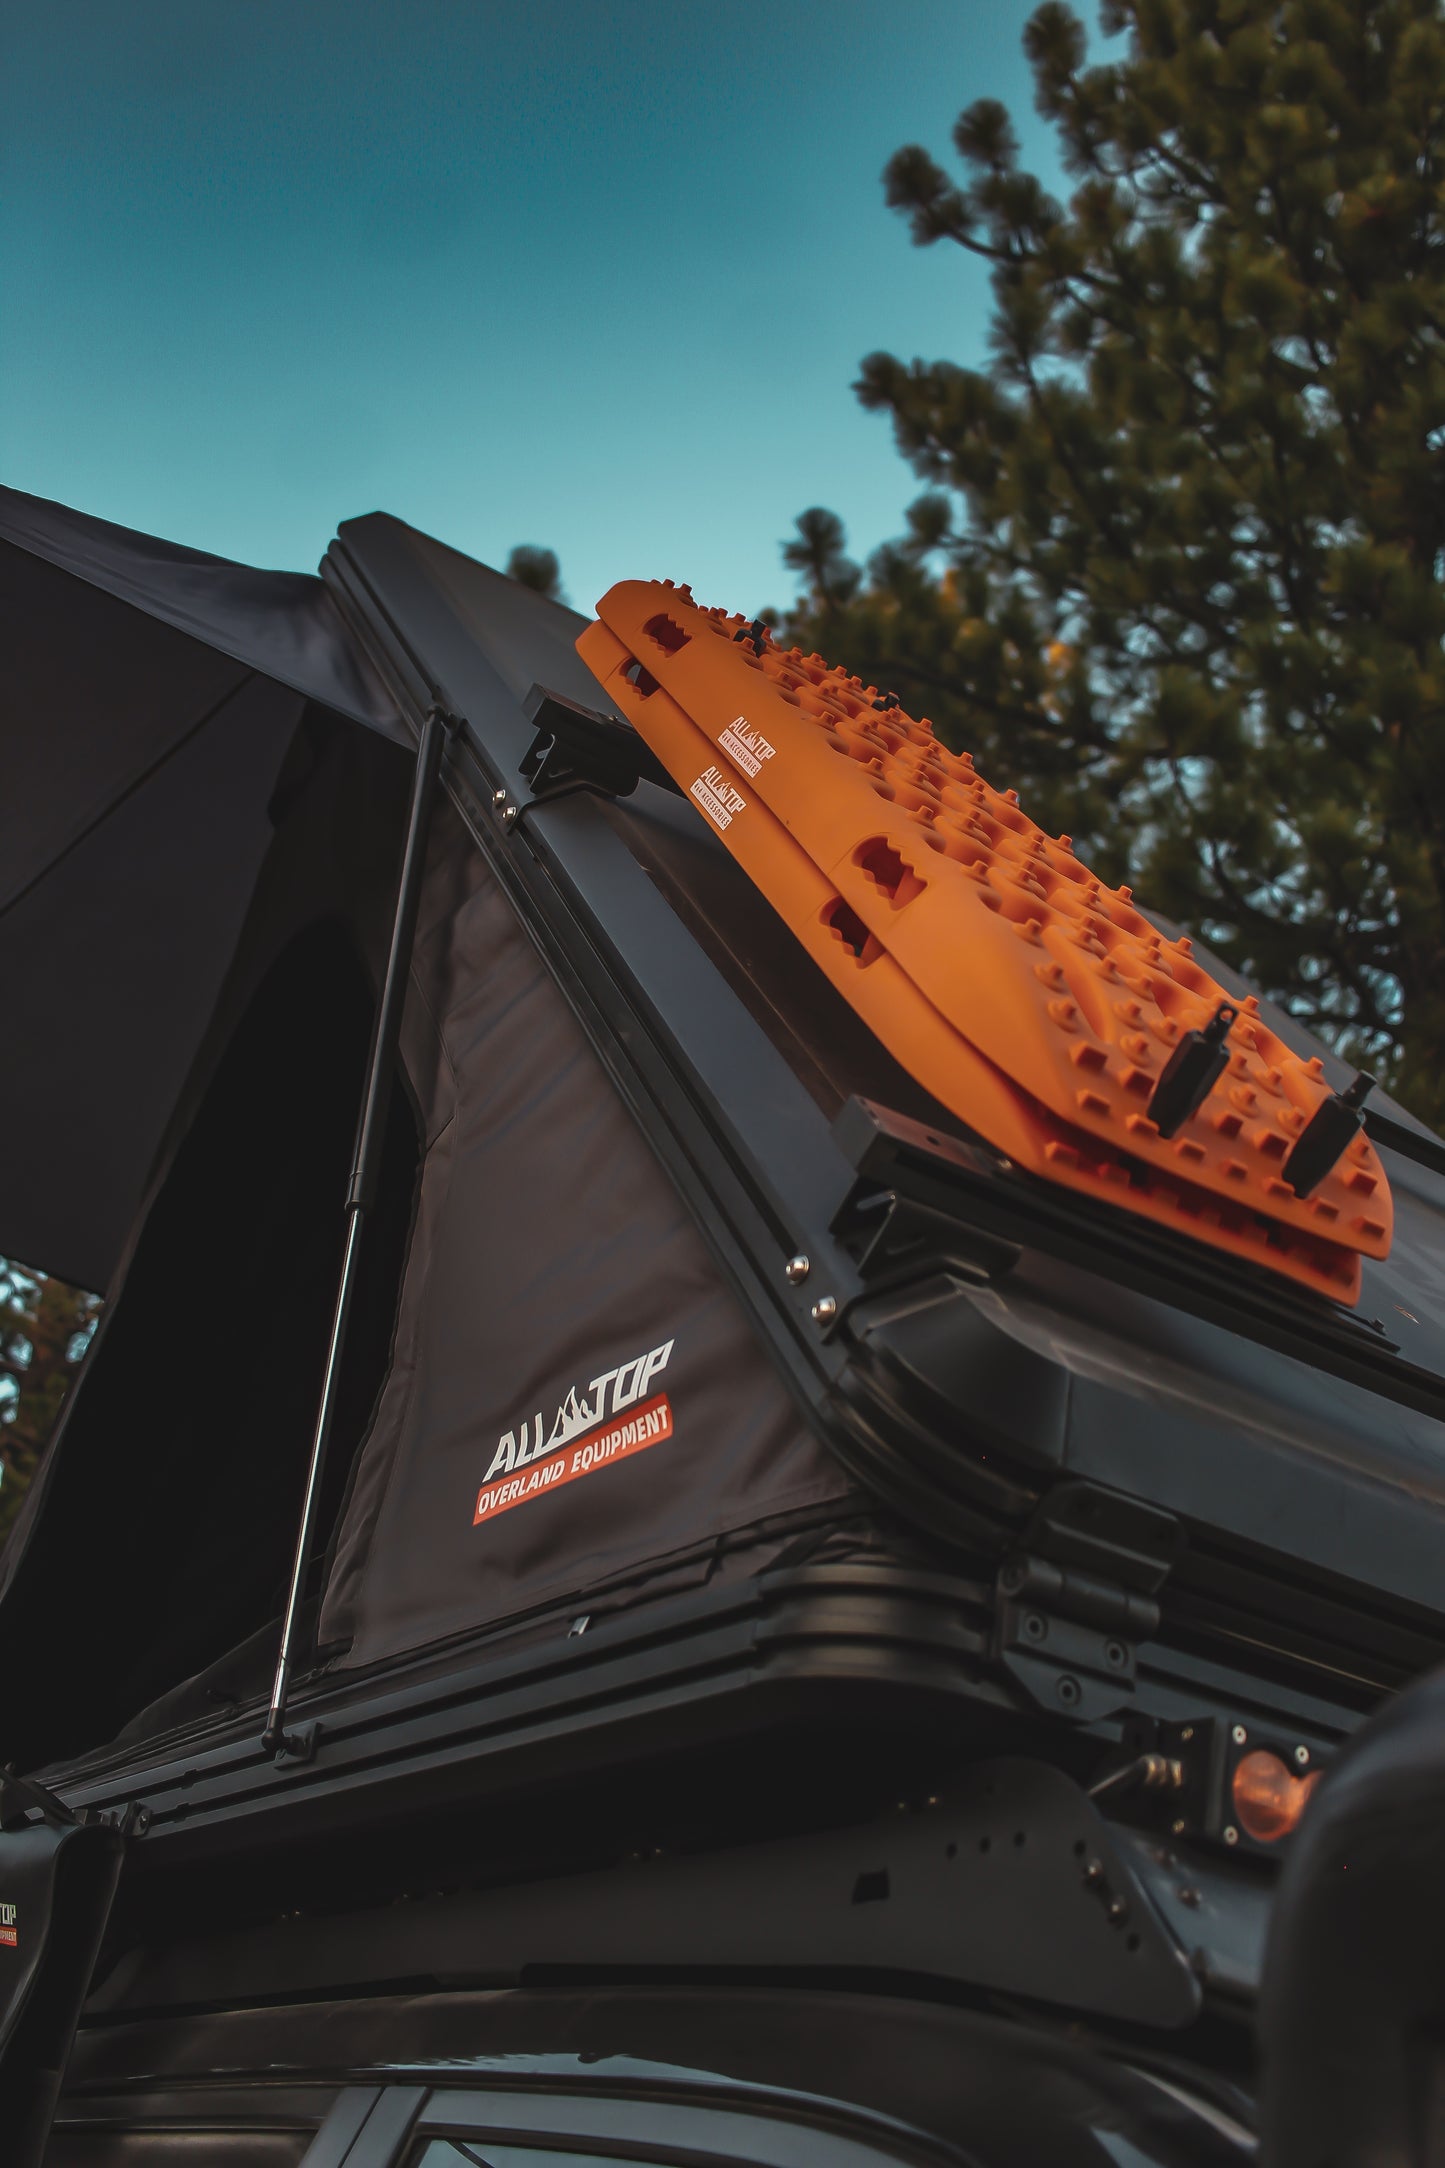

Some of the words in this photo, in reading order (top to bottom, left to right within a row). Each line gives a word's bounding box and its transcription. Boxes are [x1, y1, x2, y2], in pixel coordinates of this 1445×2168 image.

[730, 741, 759, 775] ACCESSORIES
[702, 792, 730, 827] ACCESSORIES
[478, 1459, 565, 1515] OVERLAND
[571, 1404, 668, 1470] EQUIPMENT
